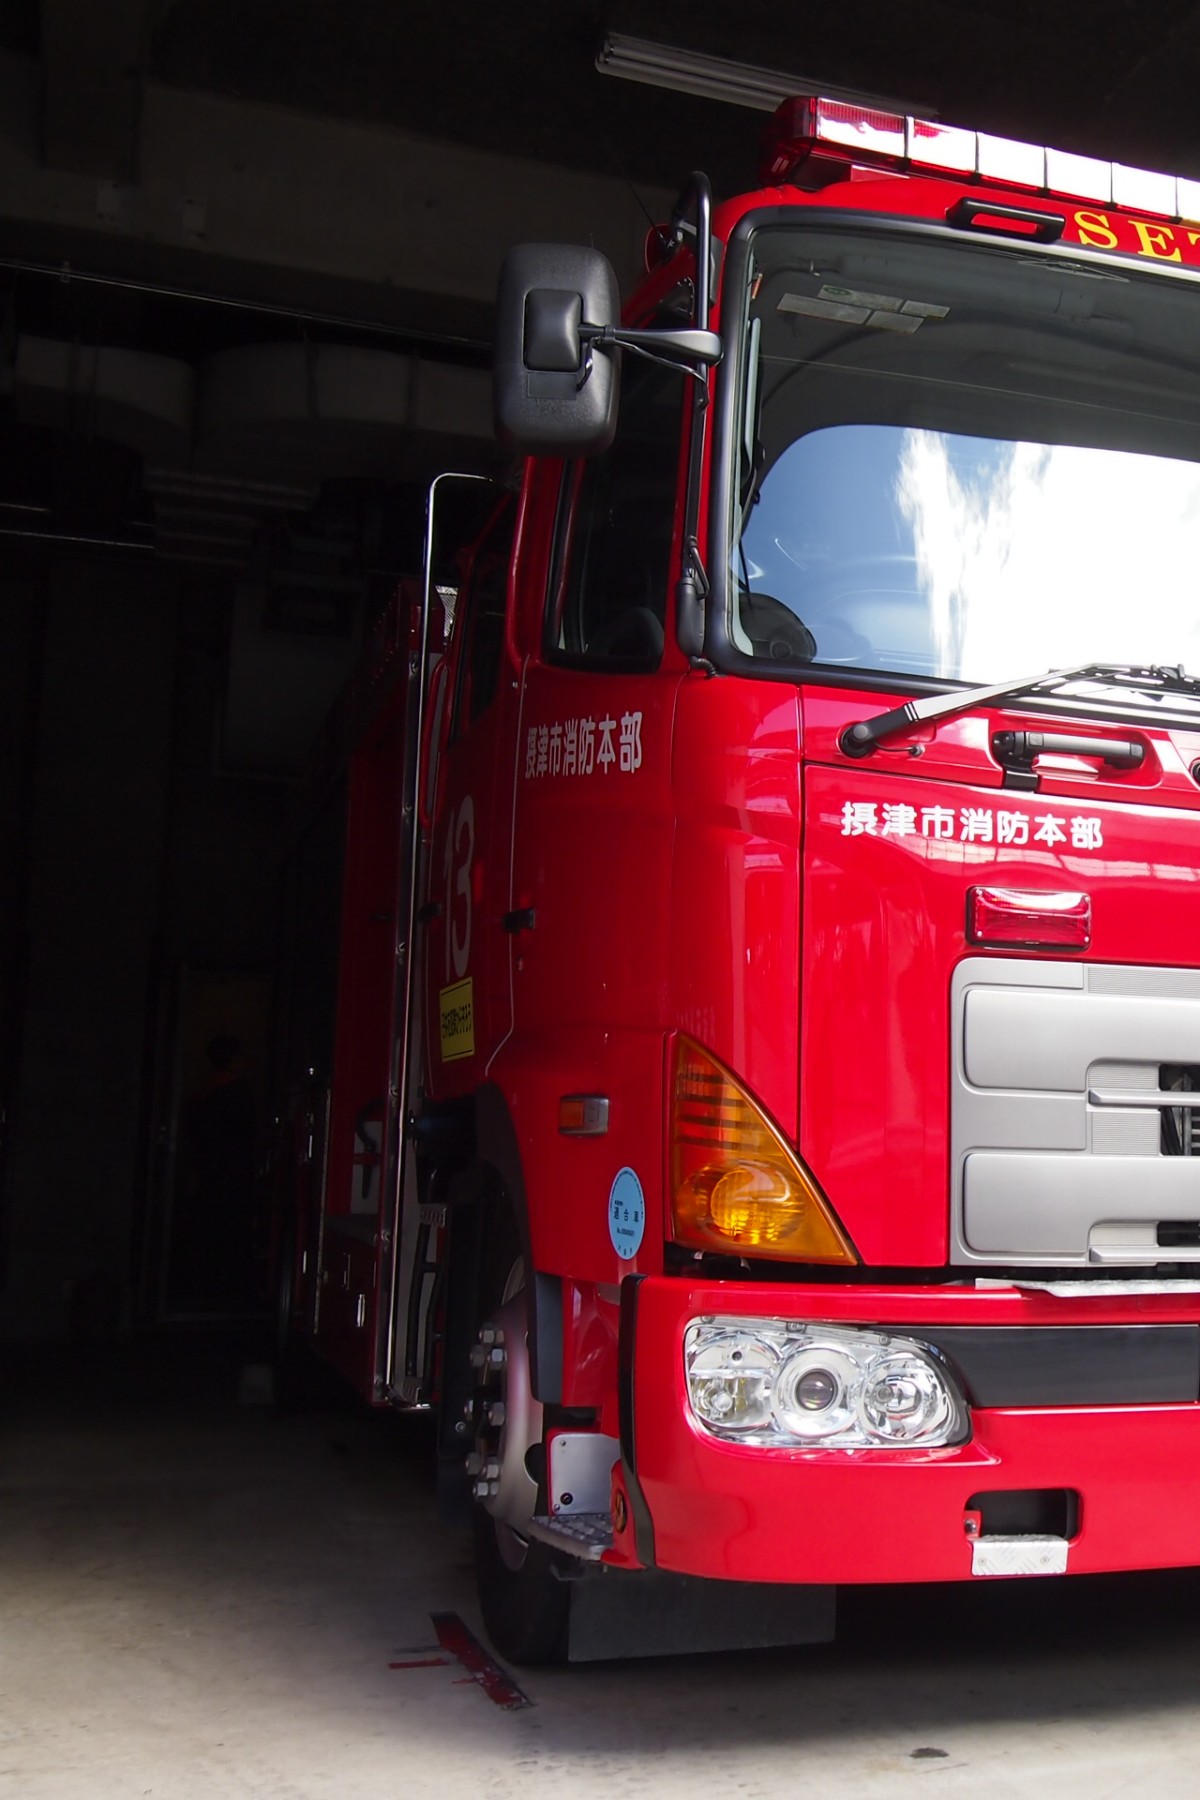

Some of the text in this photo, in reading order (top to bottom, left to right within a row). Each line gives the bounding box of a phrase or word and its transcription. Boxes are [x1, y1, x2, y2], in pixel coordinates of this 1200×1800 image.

[525, 710, 643, 779] 摂津市消防本部
[841, 801, 1104, 850] 摂津市消防本部
[443, 794, 475, 983] 13
